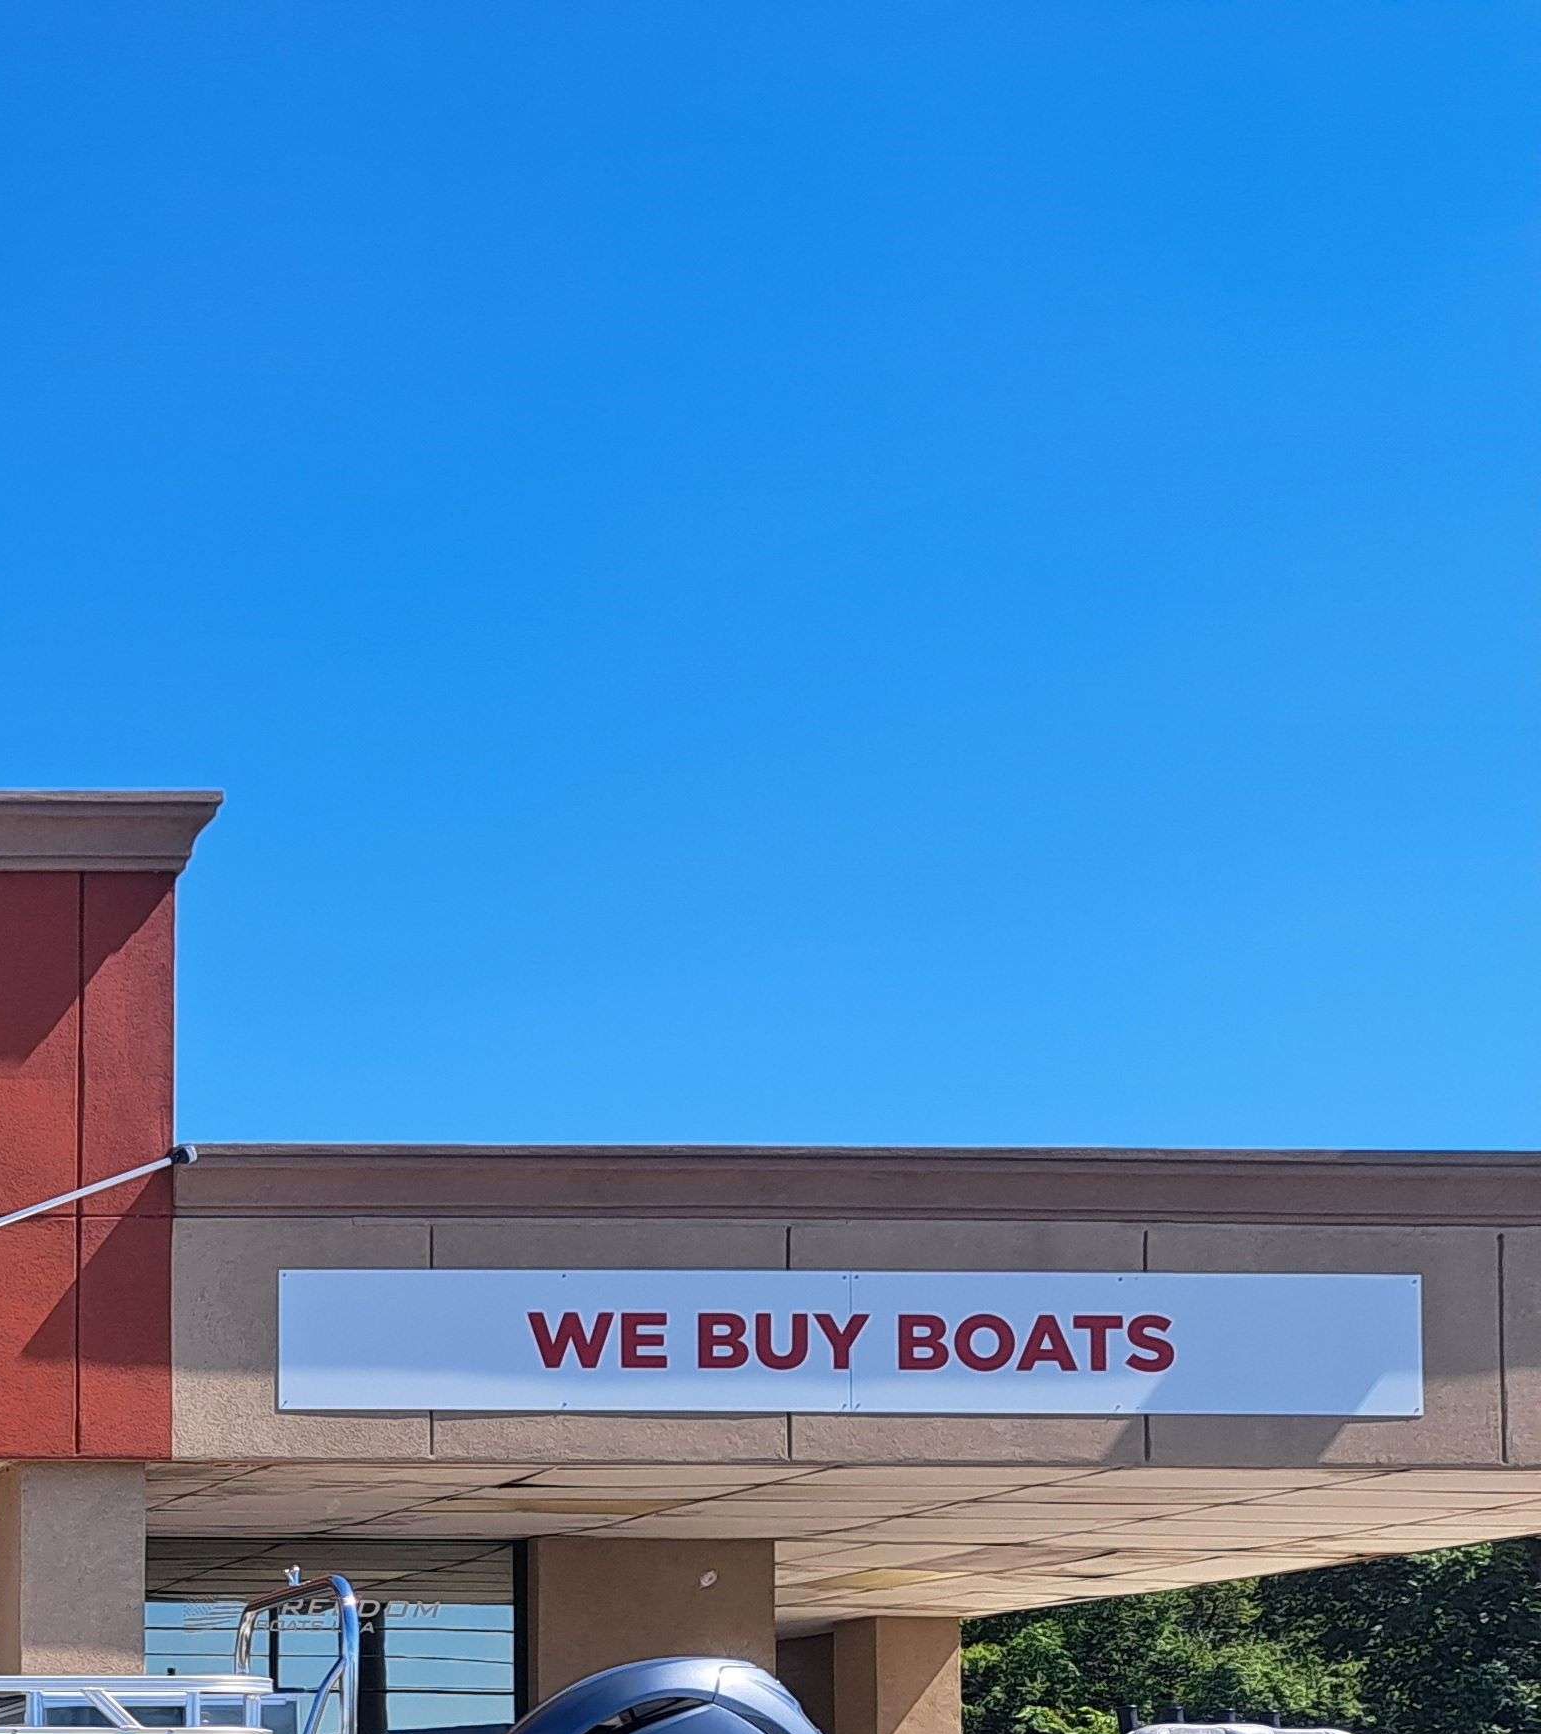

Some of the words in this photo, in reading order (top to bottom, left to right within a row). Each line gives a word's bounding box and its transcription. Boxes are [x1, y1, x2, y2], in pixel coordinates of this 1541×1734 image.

[527, 1311, 668, 1369] WE
[697, 1312, 871, 1370] BUY
[897, 1313, 1176, 1372] BOATS
